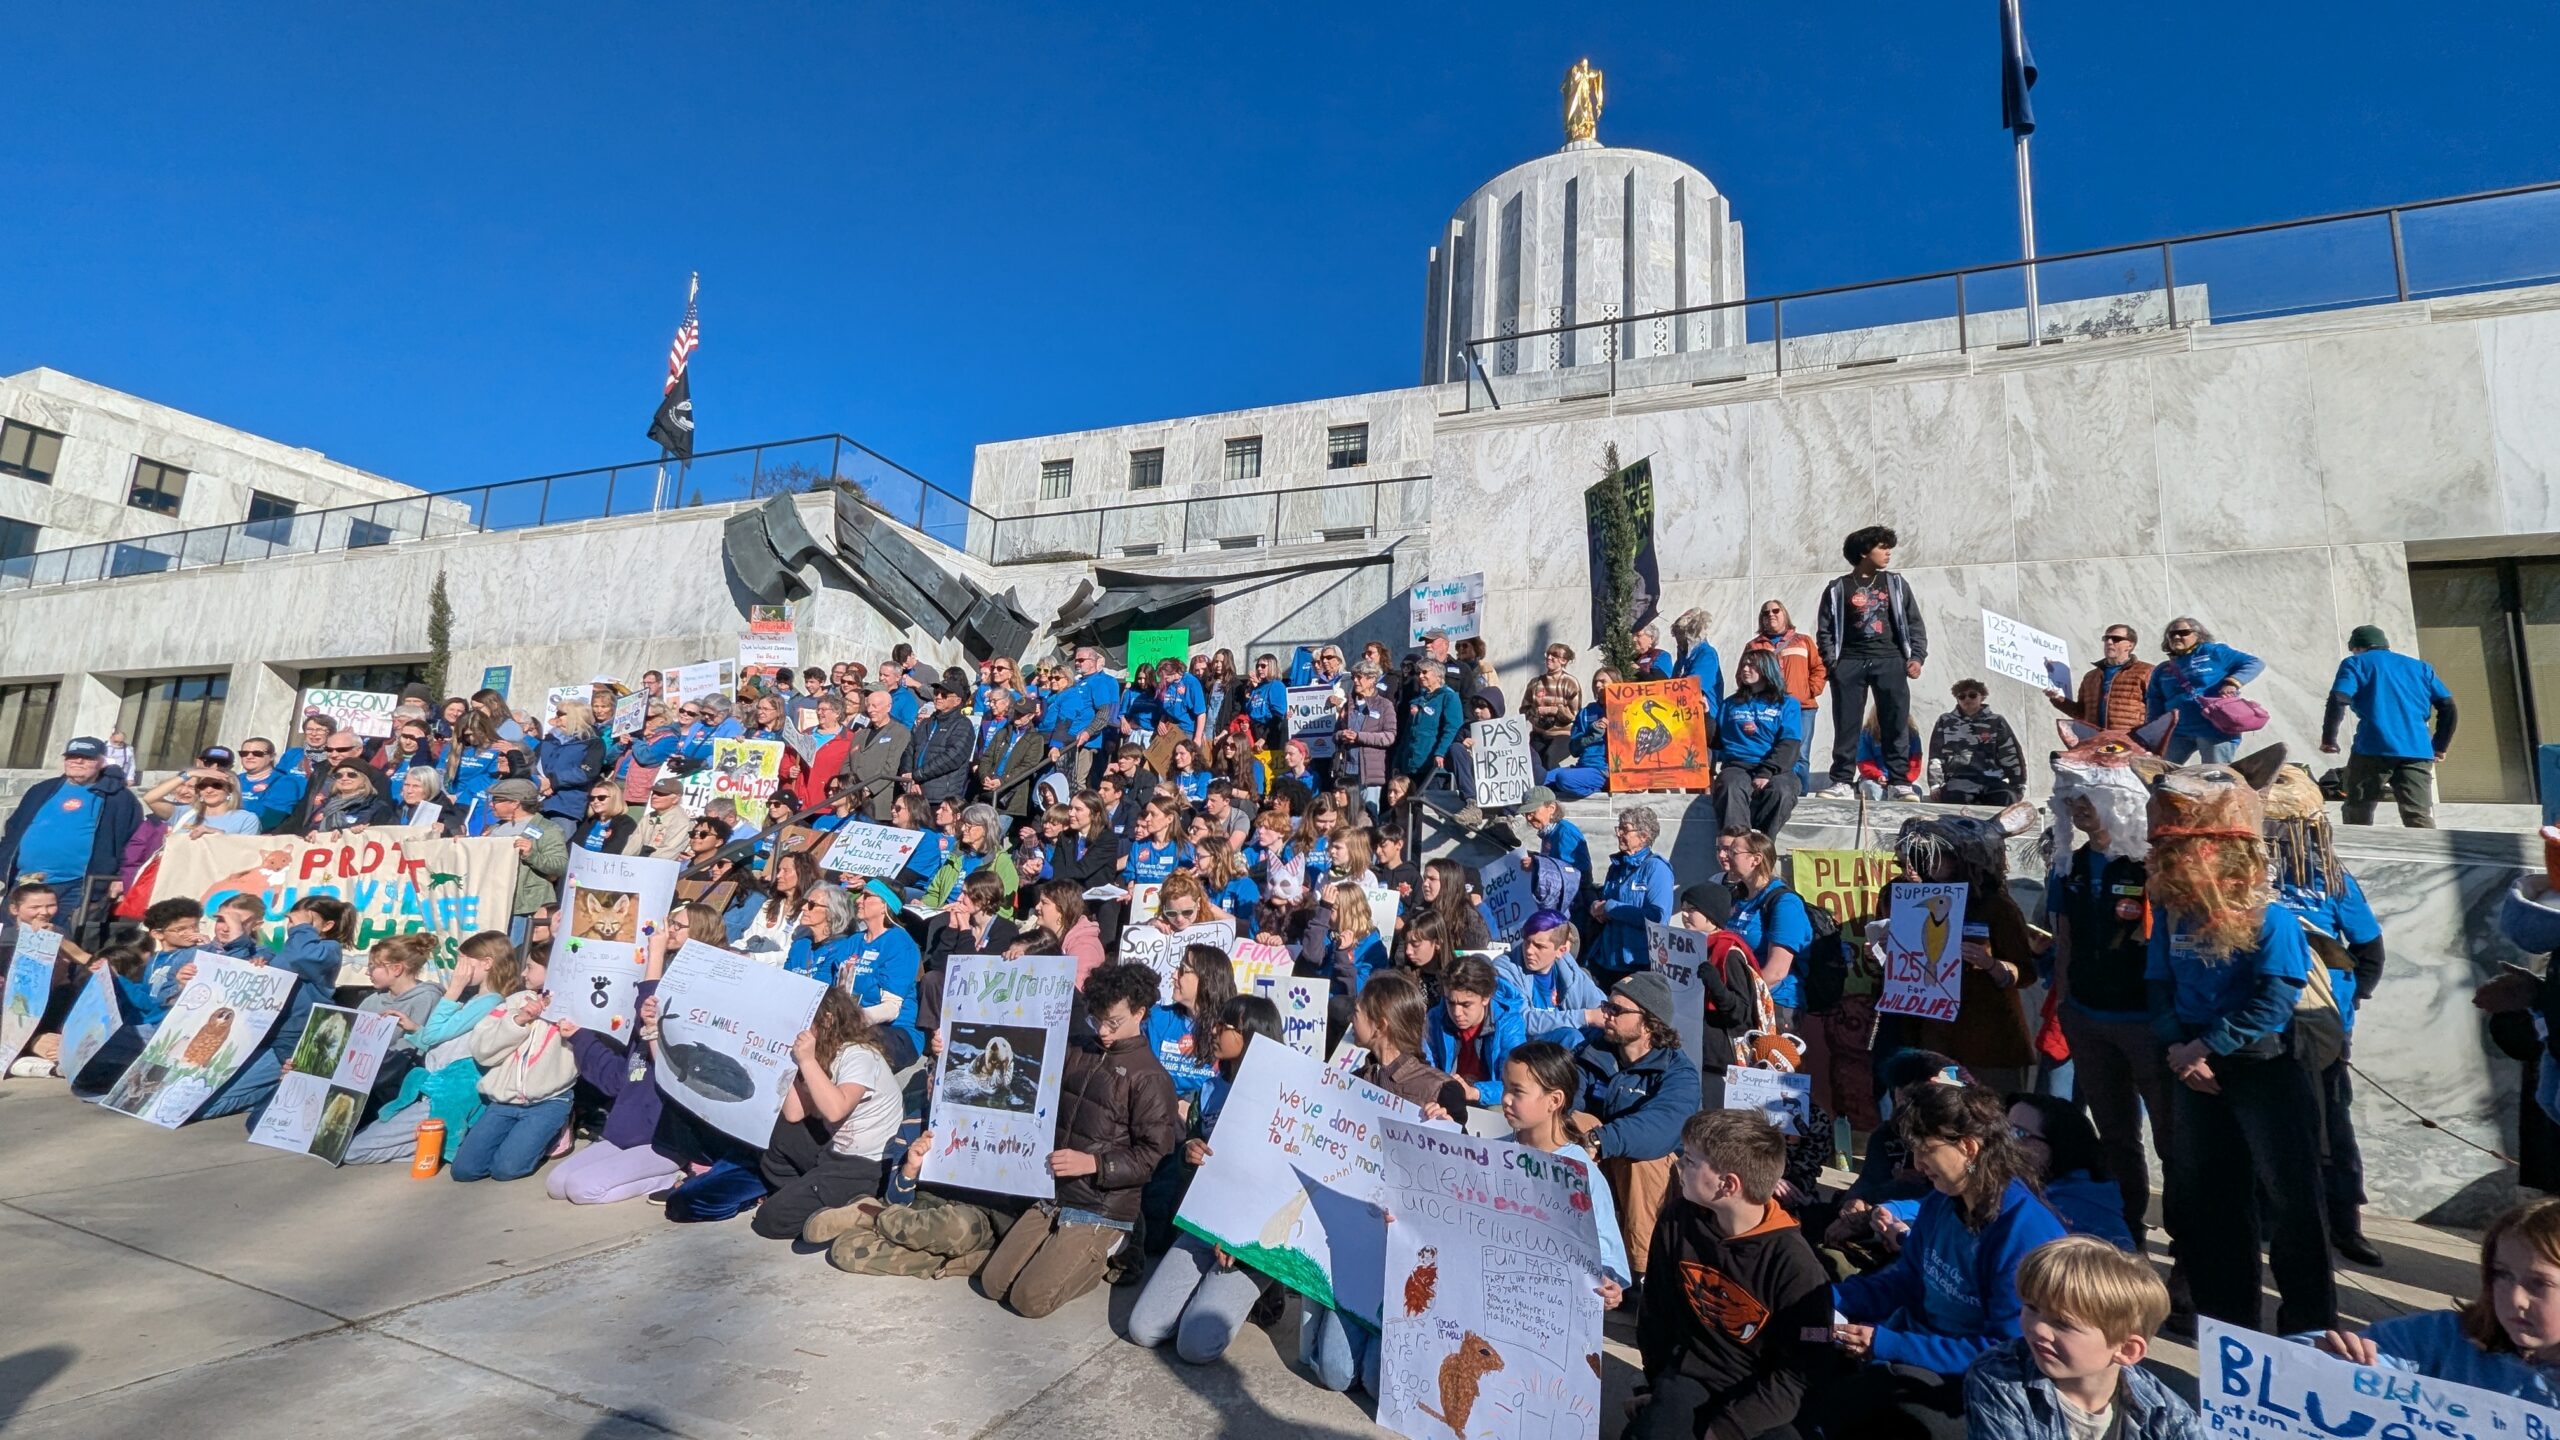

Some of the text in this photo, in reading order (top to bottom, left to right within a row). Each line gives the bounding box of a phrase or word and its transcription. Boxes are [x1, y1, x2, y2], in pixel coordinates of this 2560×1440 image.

[1413, 586, 1441, 600] When
[1427, 598, 1457, 615] Thrive
[1988, 643, 2026, 663] SMART
[2007, 640, 2018, 651] A
[560, 686, 580, 697] YES
[1664, 680, 1691, 694] FOR
[307, 689, 390, 712] OREGON
[1676, 696, 1688, 708] HB
[1293, 719, 1332, 731] Nature
[1672, 706, 1700, 722] 4134
[1475, 750, 1499, 780] HB
[1505, 755, 1528, 777] FOR
[716, 774, 754, 800] Only
[1478, 778, 1531, 805] OREGON
[843, 845, 893, 863] WILDLIFE
[861, 838, 883, 851] OUR
[620, 861, 636, 878] Fox
[1814, 856, 1903, 888] PLANE
[1368, 891, 1388, 902] FOR
[1894, 885, 1965, 900] SUPPORT
[1121, 926, 1164, 955] Save
[1172, 923, 1222, 945] Support
[1668, 932, 1697, 954] FOR
[214, 967, 284, 997] NORTHERN
[1878, 991, 1961, 1020] WILDLIFE
[688, 1007, 740, 1035] SEI WHALE
[745, 1030, 793, 1057] 500 LEFT
[1321, 1067, 1356, 1091] gray
[1741, 1069, 1775, 1088] Support
[1279, 1081, 1323, 1119] We've
[1328, 1108, 1368, 1142] done
[1417, 1132, 1490, 1166] ground
[1484, 1248, 1563, 1277] FUN FACTS
[1384, 1321, 1431, 1351] There
[1384, 1338, 1413, 1362] are
[2491, 1411, 2508, 1431] in
